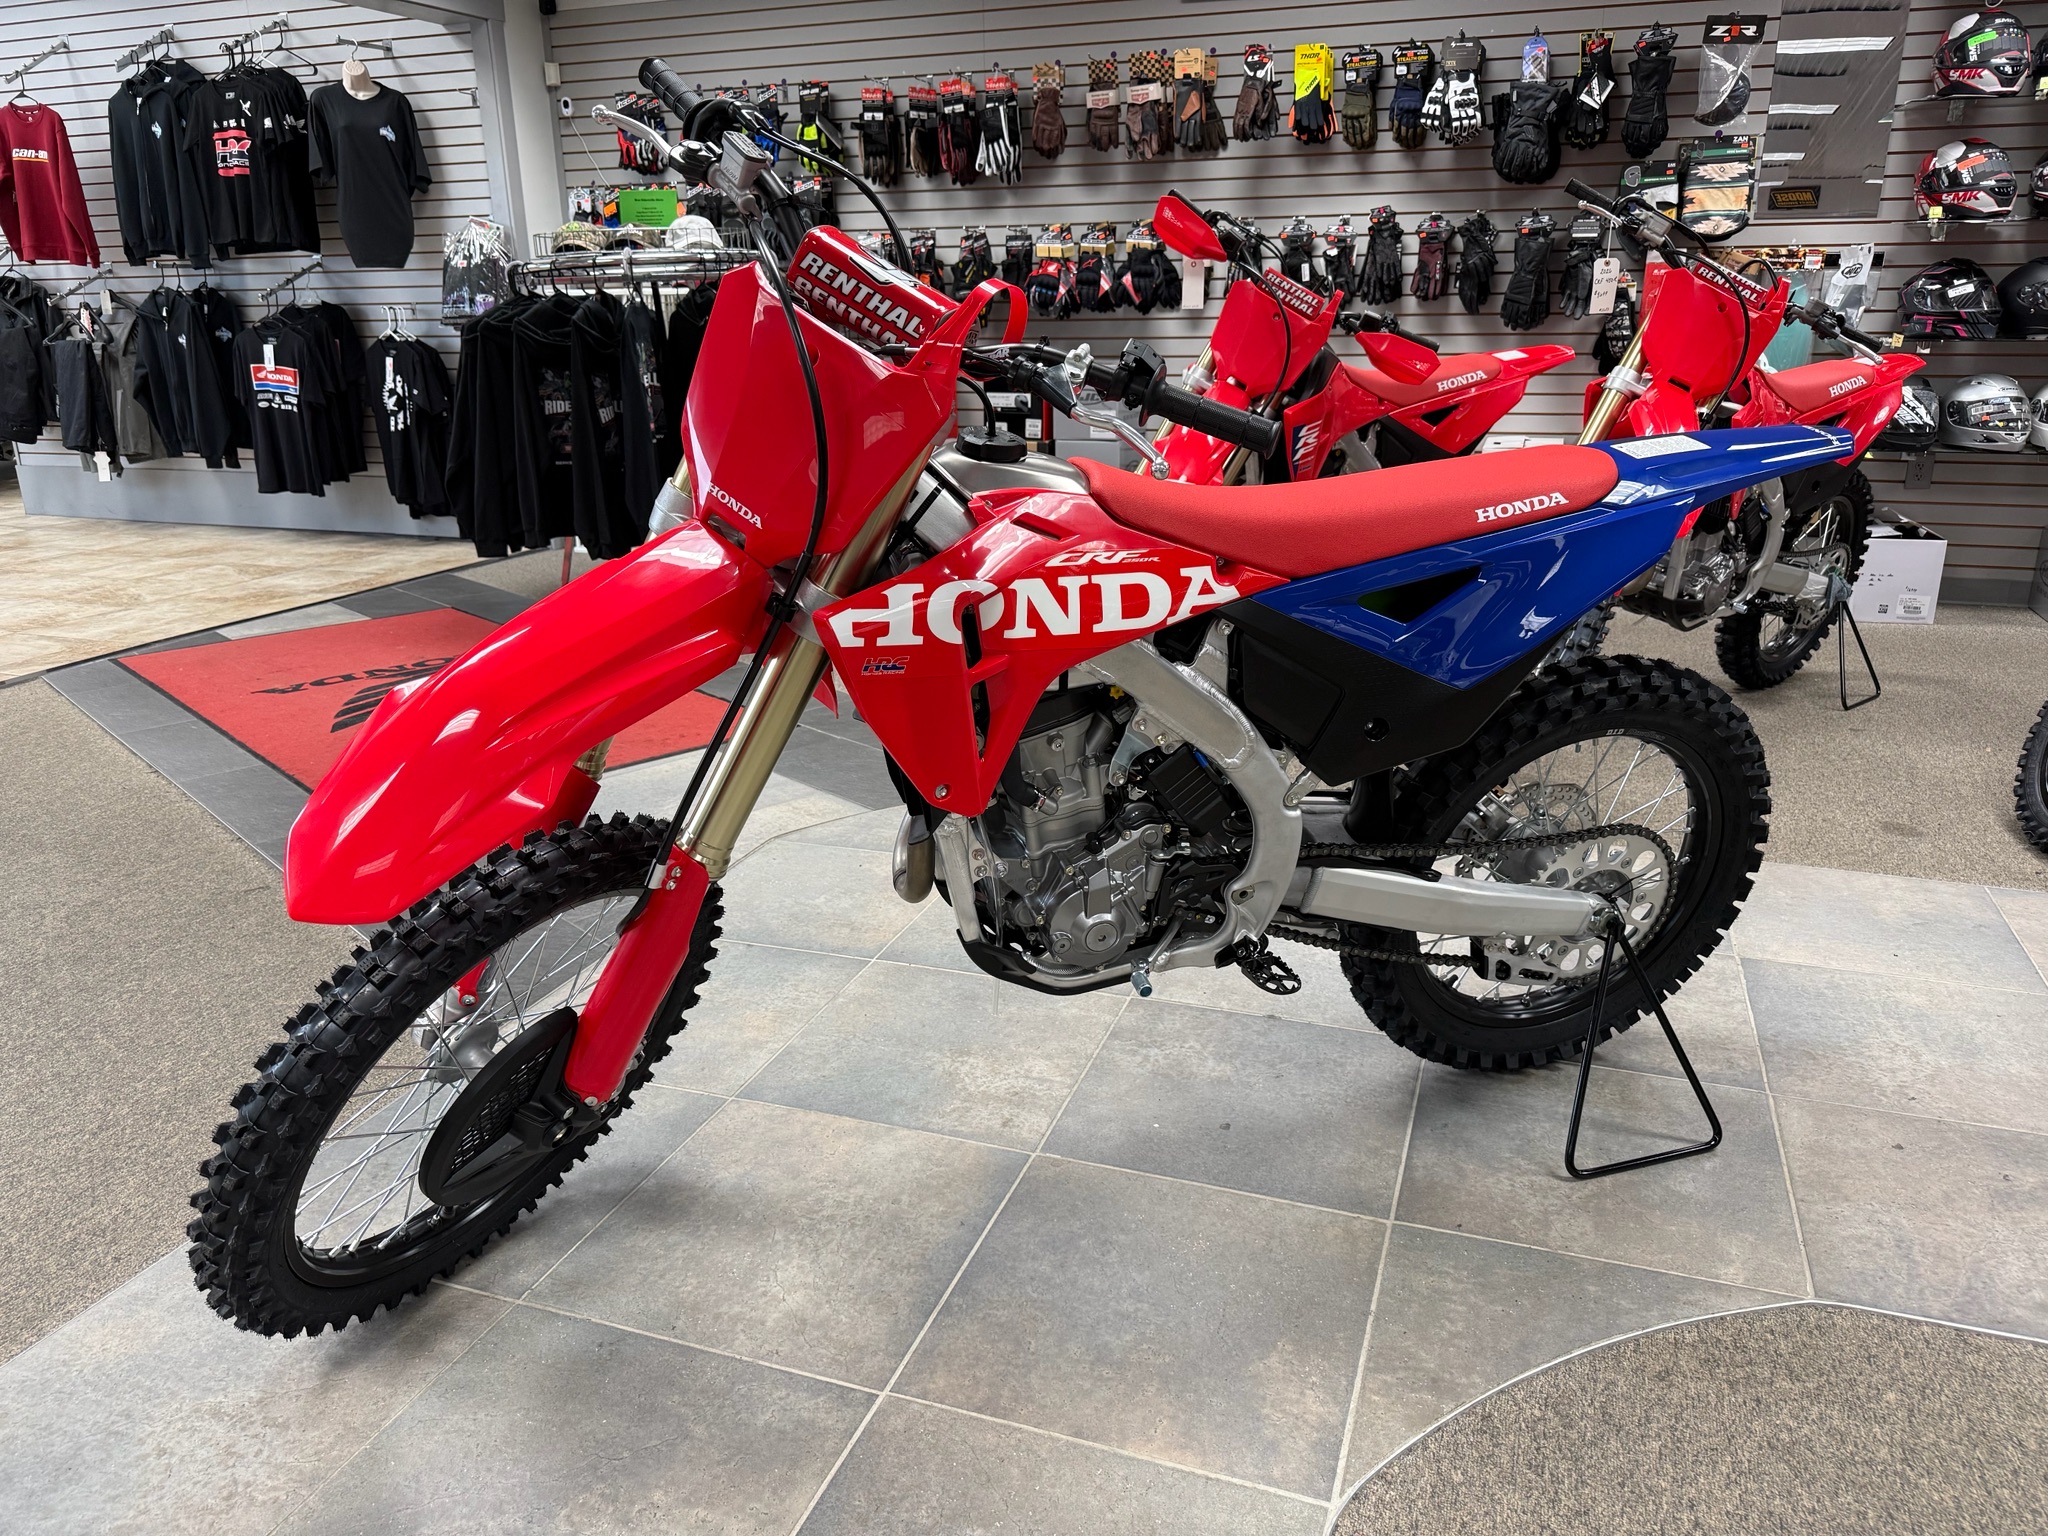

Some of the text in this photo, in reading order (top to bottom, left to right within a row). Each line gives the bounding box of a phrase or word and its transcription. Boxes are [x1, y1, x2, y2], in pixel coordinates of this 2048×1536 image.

[1305, 75, 1319, 93] THOR
[1949, 68, 1984, 81] SMK
[1941, 190, 1980, 204] SMK
[799, 252, 922, 339] RENTHAL
[1266, 272, 1319, 308] RENTHAL
[794, 275, 910, 347] RENTHA
[1436, 370, 1488, 392] HONDA
[1828, 375, 1868, 398] HONDA
[544, 400, 572, 415] RIDE
[707, 481, 763, 530] HONDA
[1475, 492, 1569, 523] HONDA
[1044, 549, 1150, 567] CRF
[828, 565, 1241, 648] HONDA
[251, 657, 456, 694] ONDA
[862, 656, 910, 672] HRC
